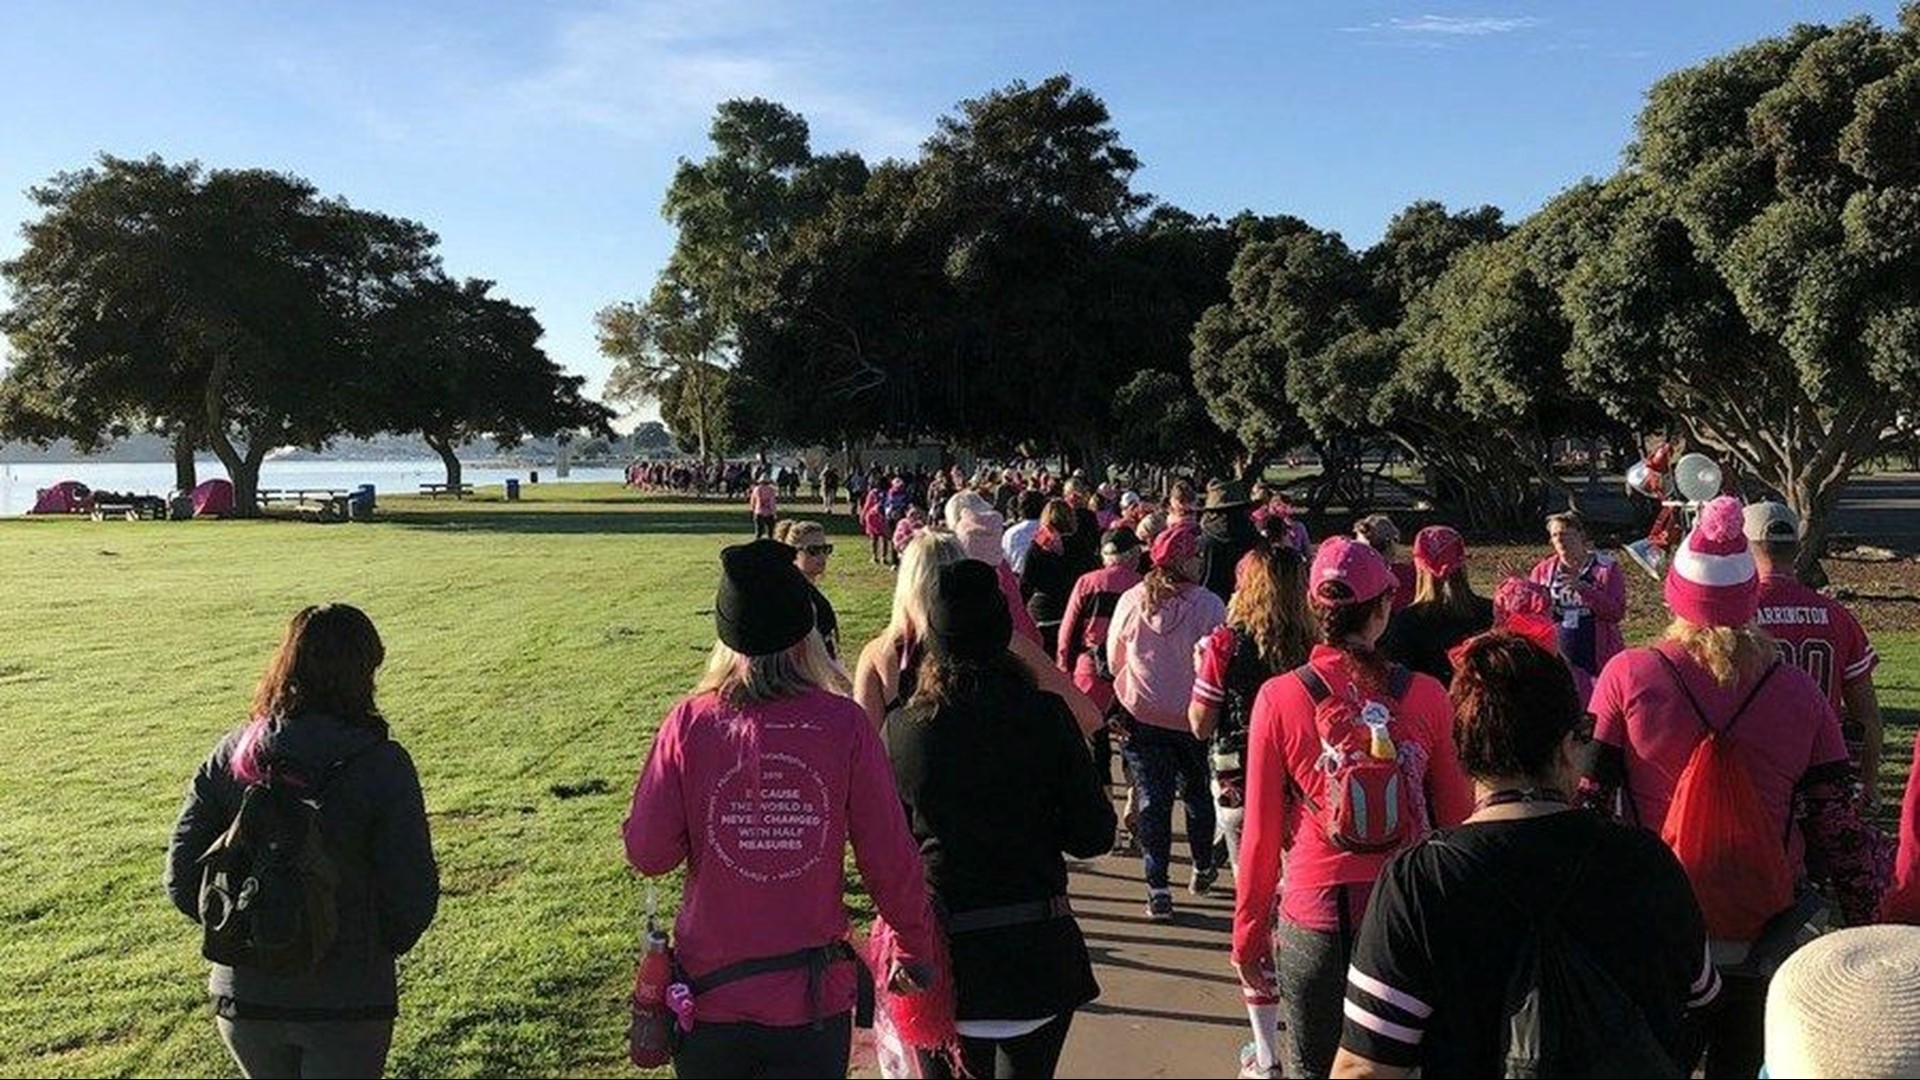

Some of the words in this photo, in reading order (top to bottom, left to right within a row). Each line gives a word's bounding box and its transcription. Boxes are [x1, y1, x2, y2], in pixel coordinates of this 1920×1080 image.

[745, 788, 800, 799] BCAUSE
[763, 815, 821, 826] CHANGED
[738, 840, 803, 850] MEASURES
